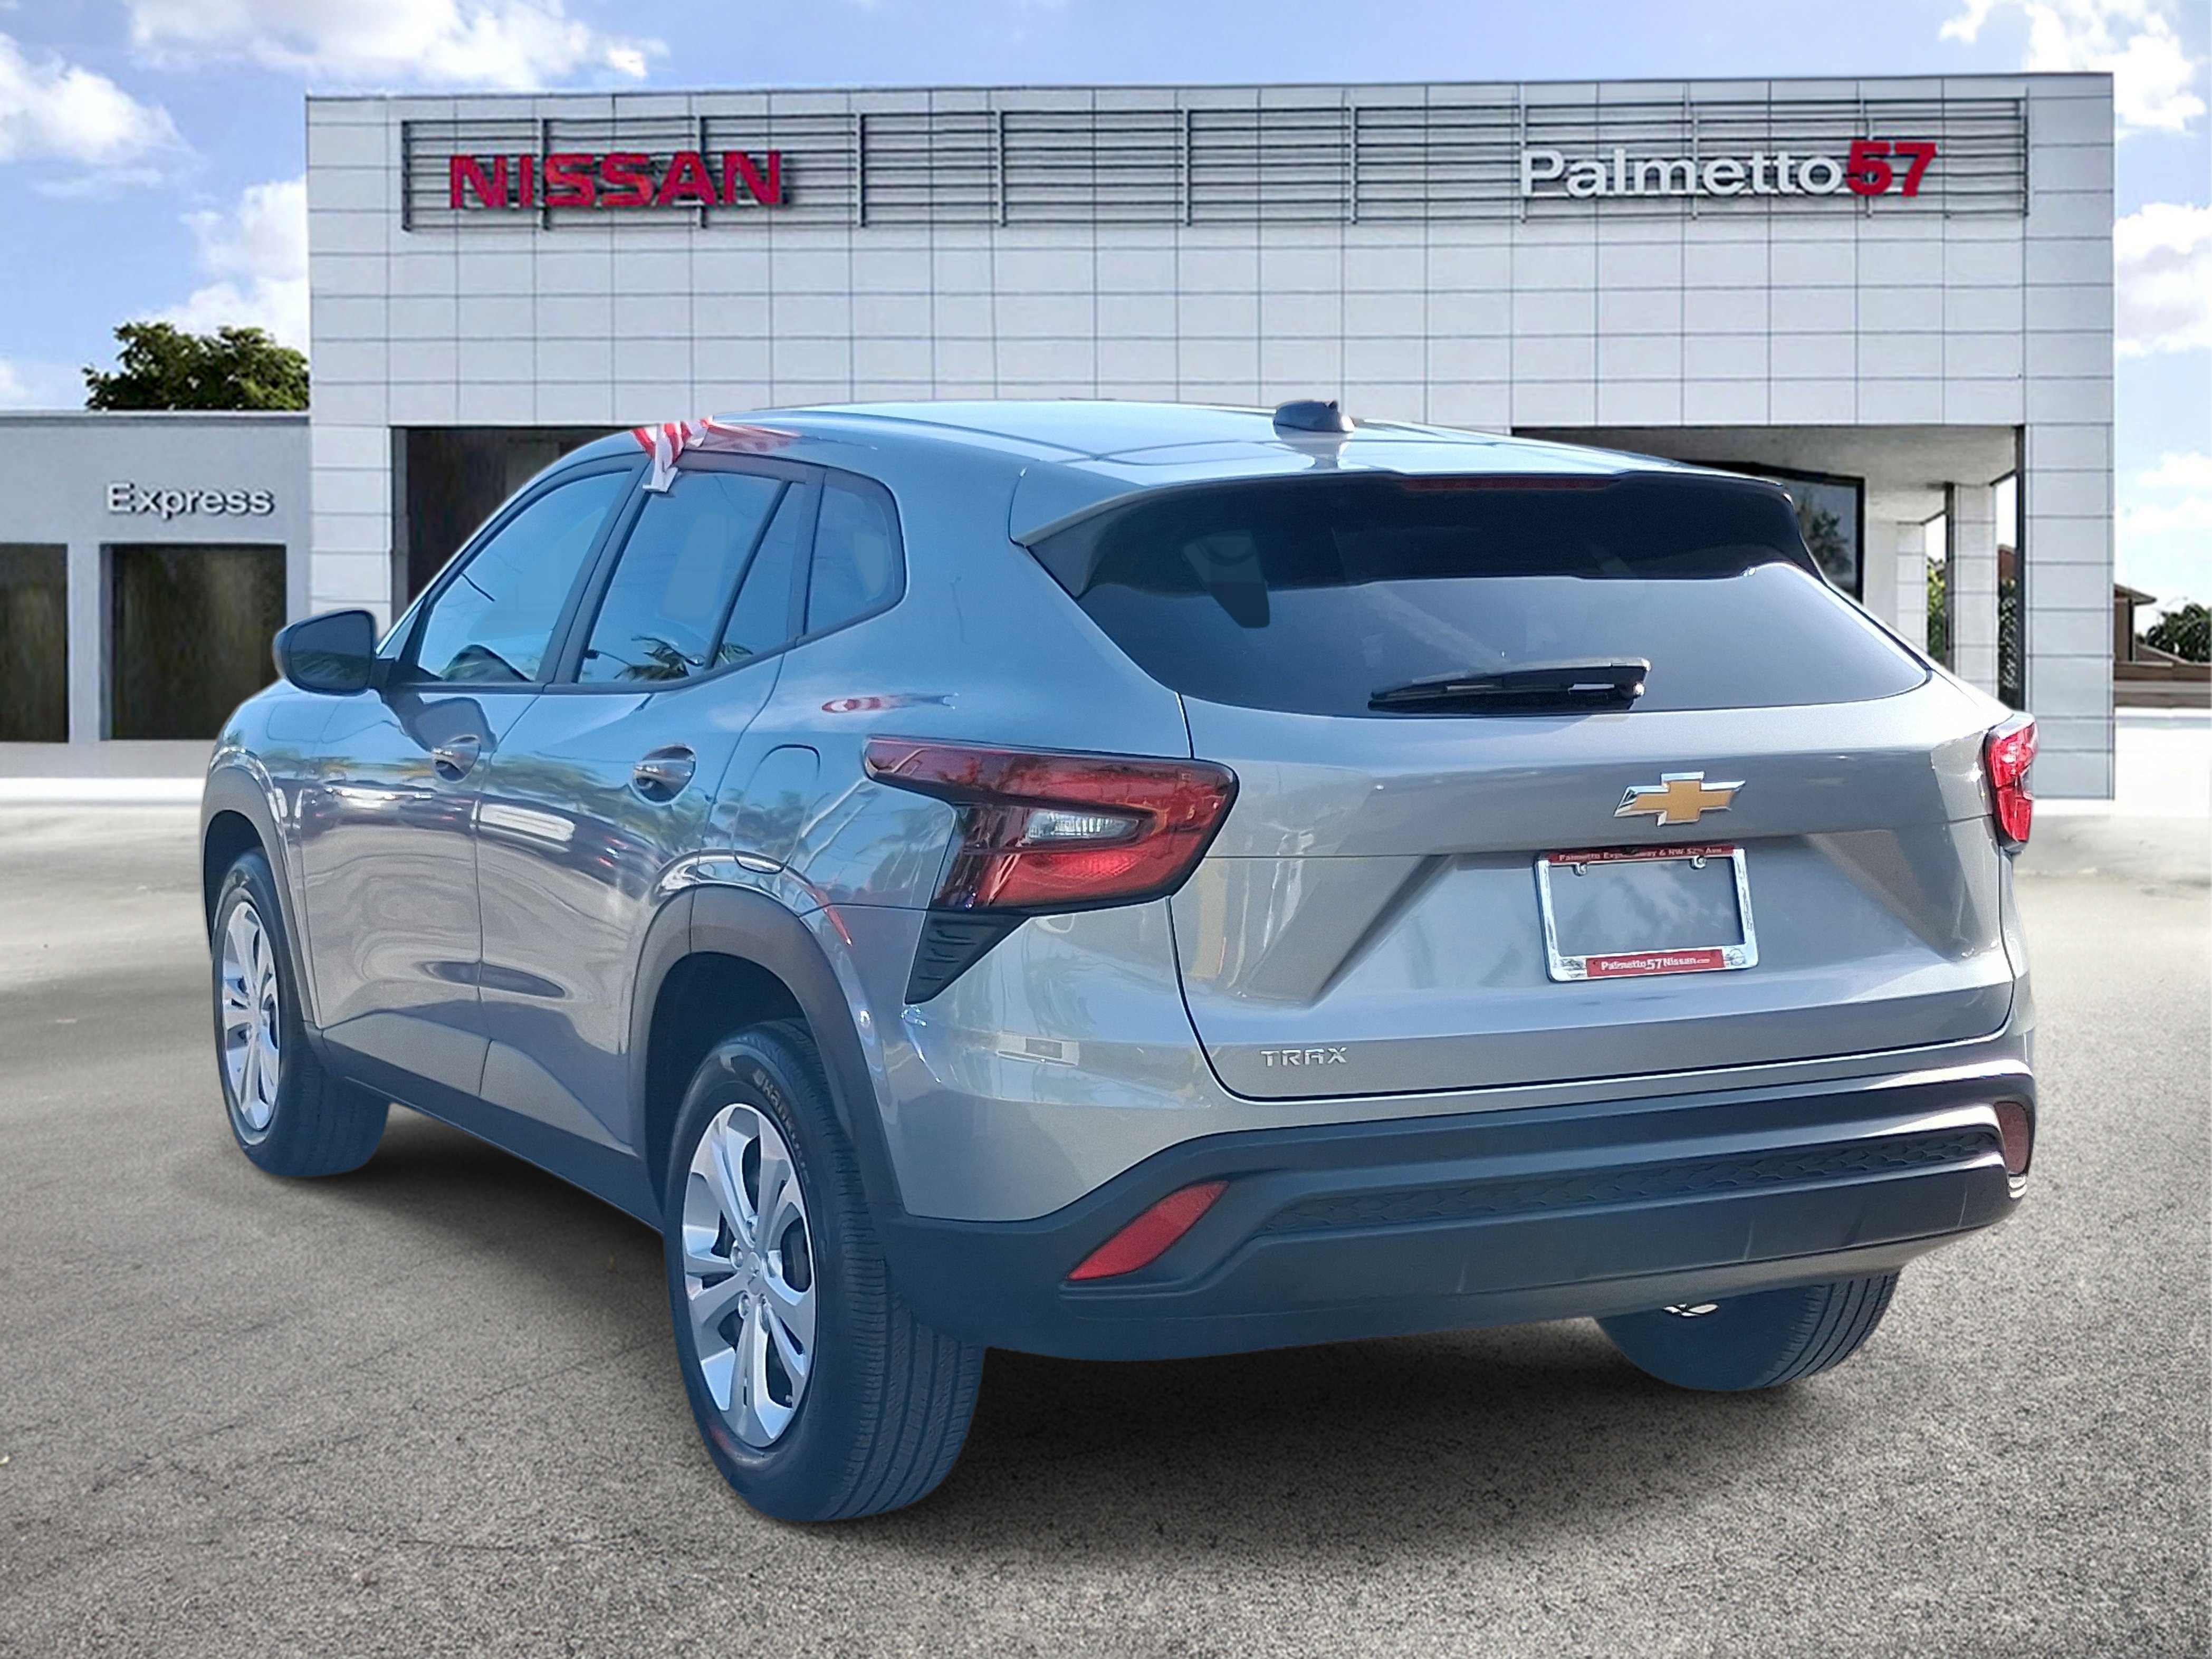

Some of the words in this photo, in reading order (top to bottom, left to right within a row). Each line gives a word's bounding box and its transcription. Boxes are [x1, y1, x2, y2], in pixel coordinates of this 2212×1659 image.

[449, 150, 782, 209] NISSAN
[107, 482, 274, 520] Express
[1260, 1047, 1347, 1067] TRAX
